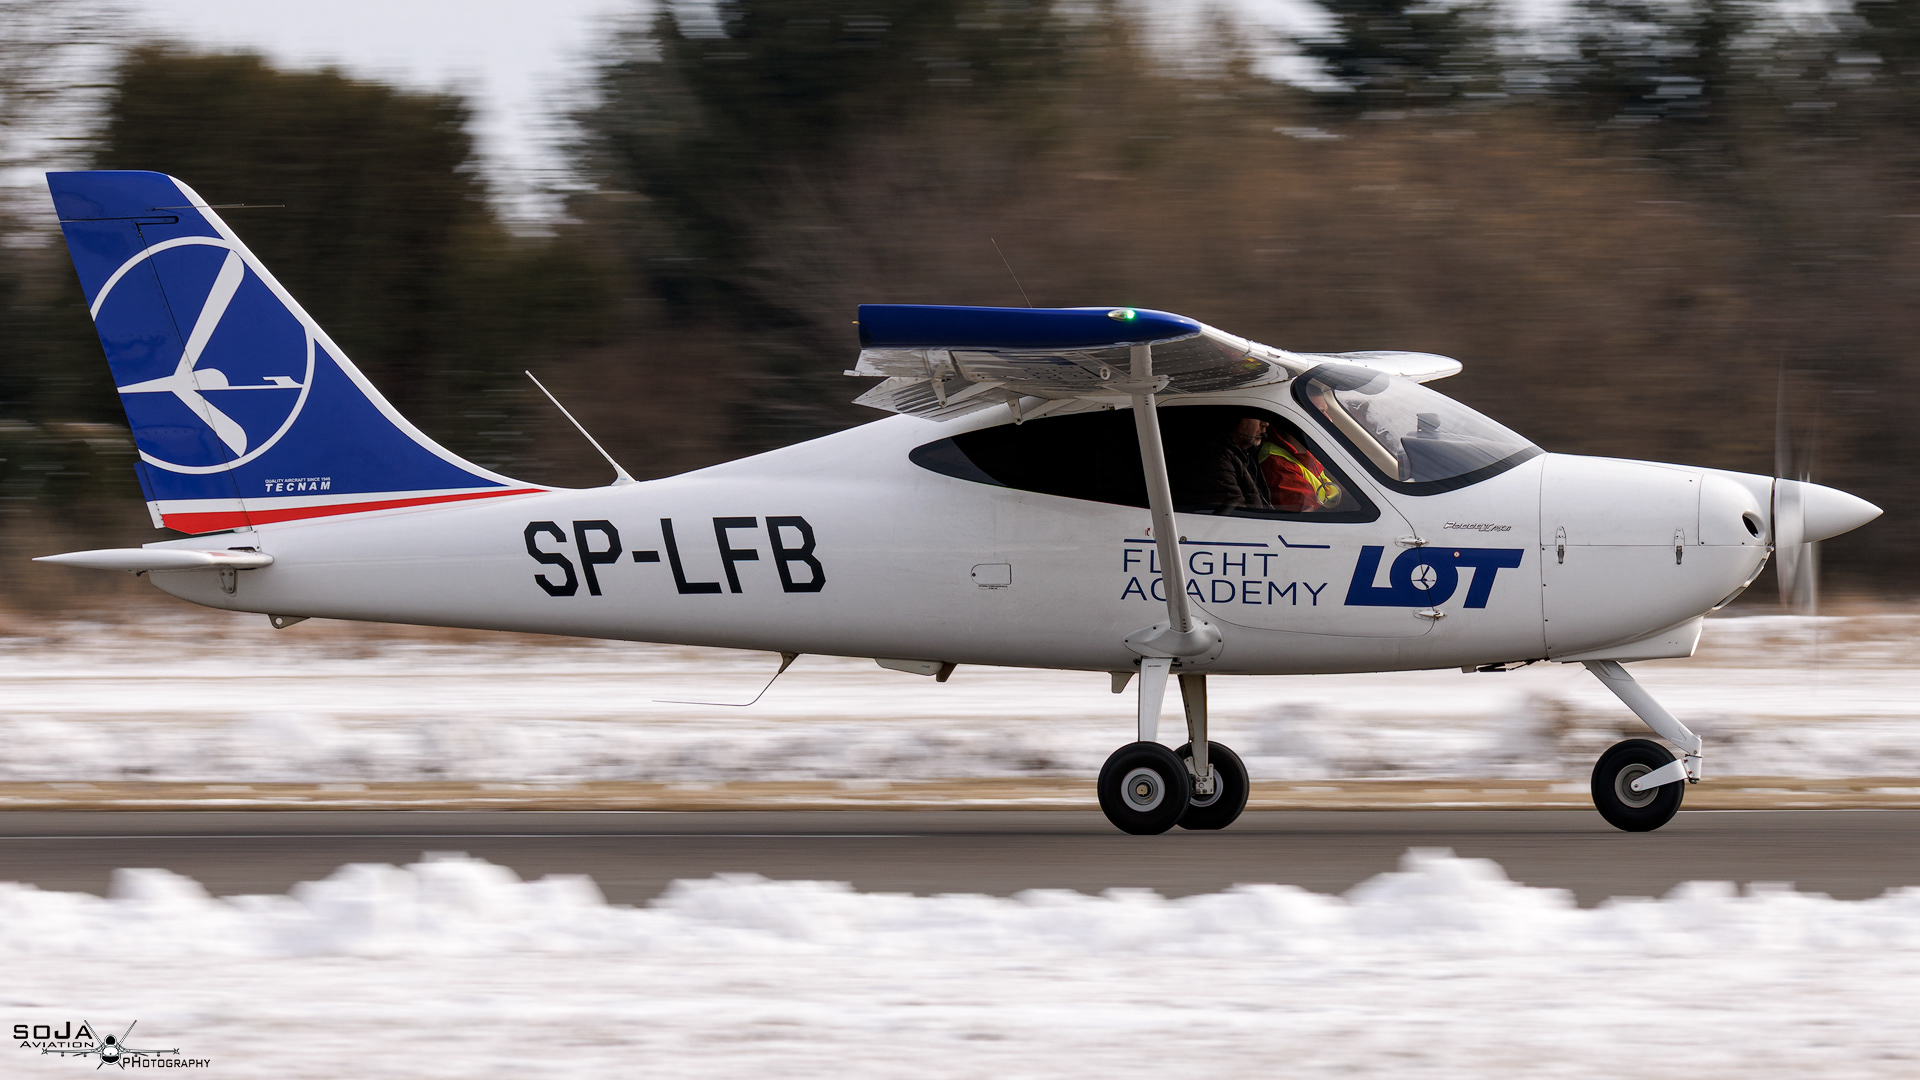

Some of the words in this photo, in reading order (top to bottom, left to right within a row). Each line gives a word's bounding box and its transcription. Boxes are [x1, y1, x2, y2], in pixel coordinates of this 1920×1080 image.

[265, 481, 331, 492] TECNAM
[523, 516, 826, 597] SP-LFB
[1123, 548, 1279, 577] FLGHT
[1344, 545, 1525, 609] LOT
